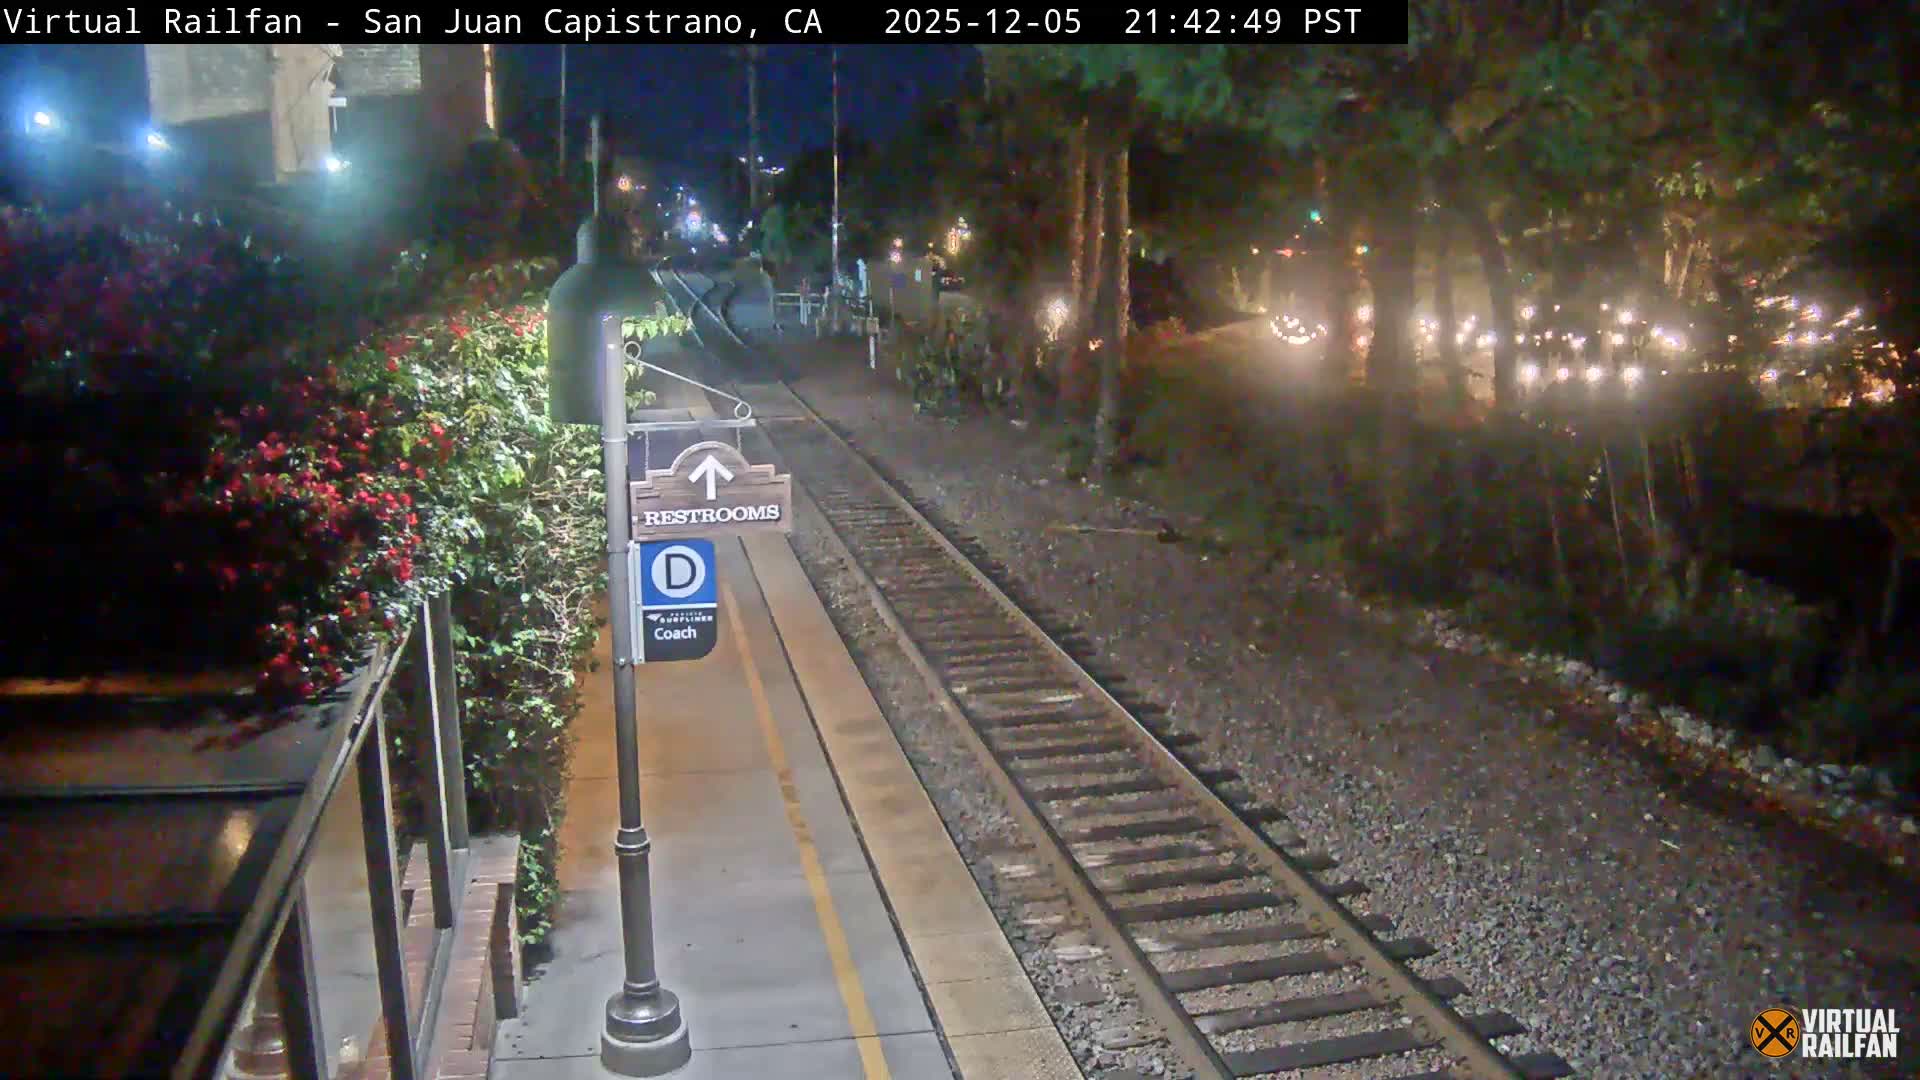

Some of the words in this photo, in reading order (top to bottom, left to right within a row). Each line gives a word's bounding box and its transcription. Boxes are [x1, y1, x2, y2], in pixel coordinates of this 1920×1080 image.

[644, 504, 780, 526] RESTROOMS
[665, 553, 697, 590] D
[654, 625, 697, 641] Coach
